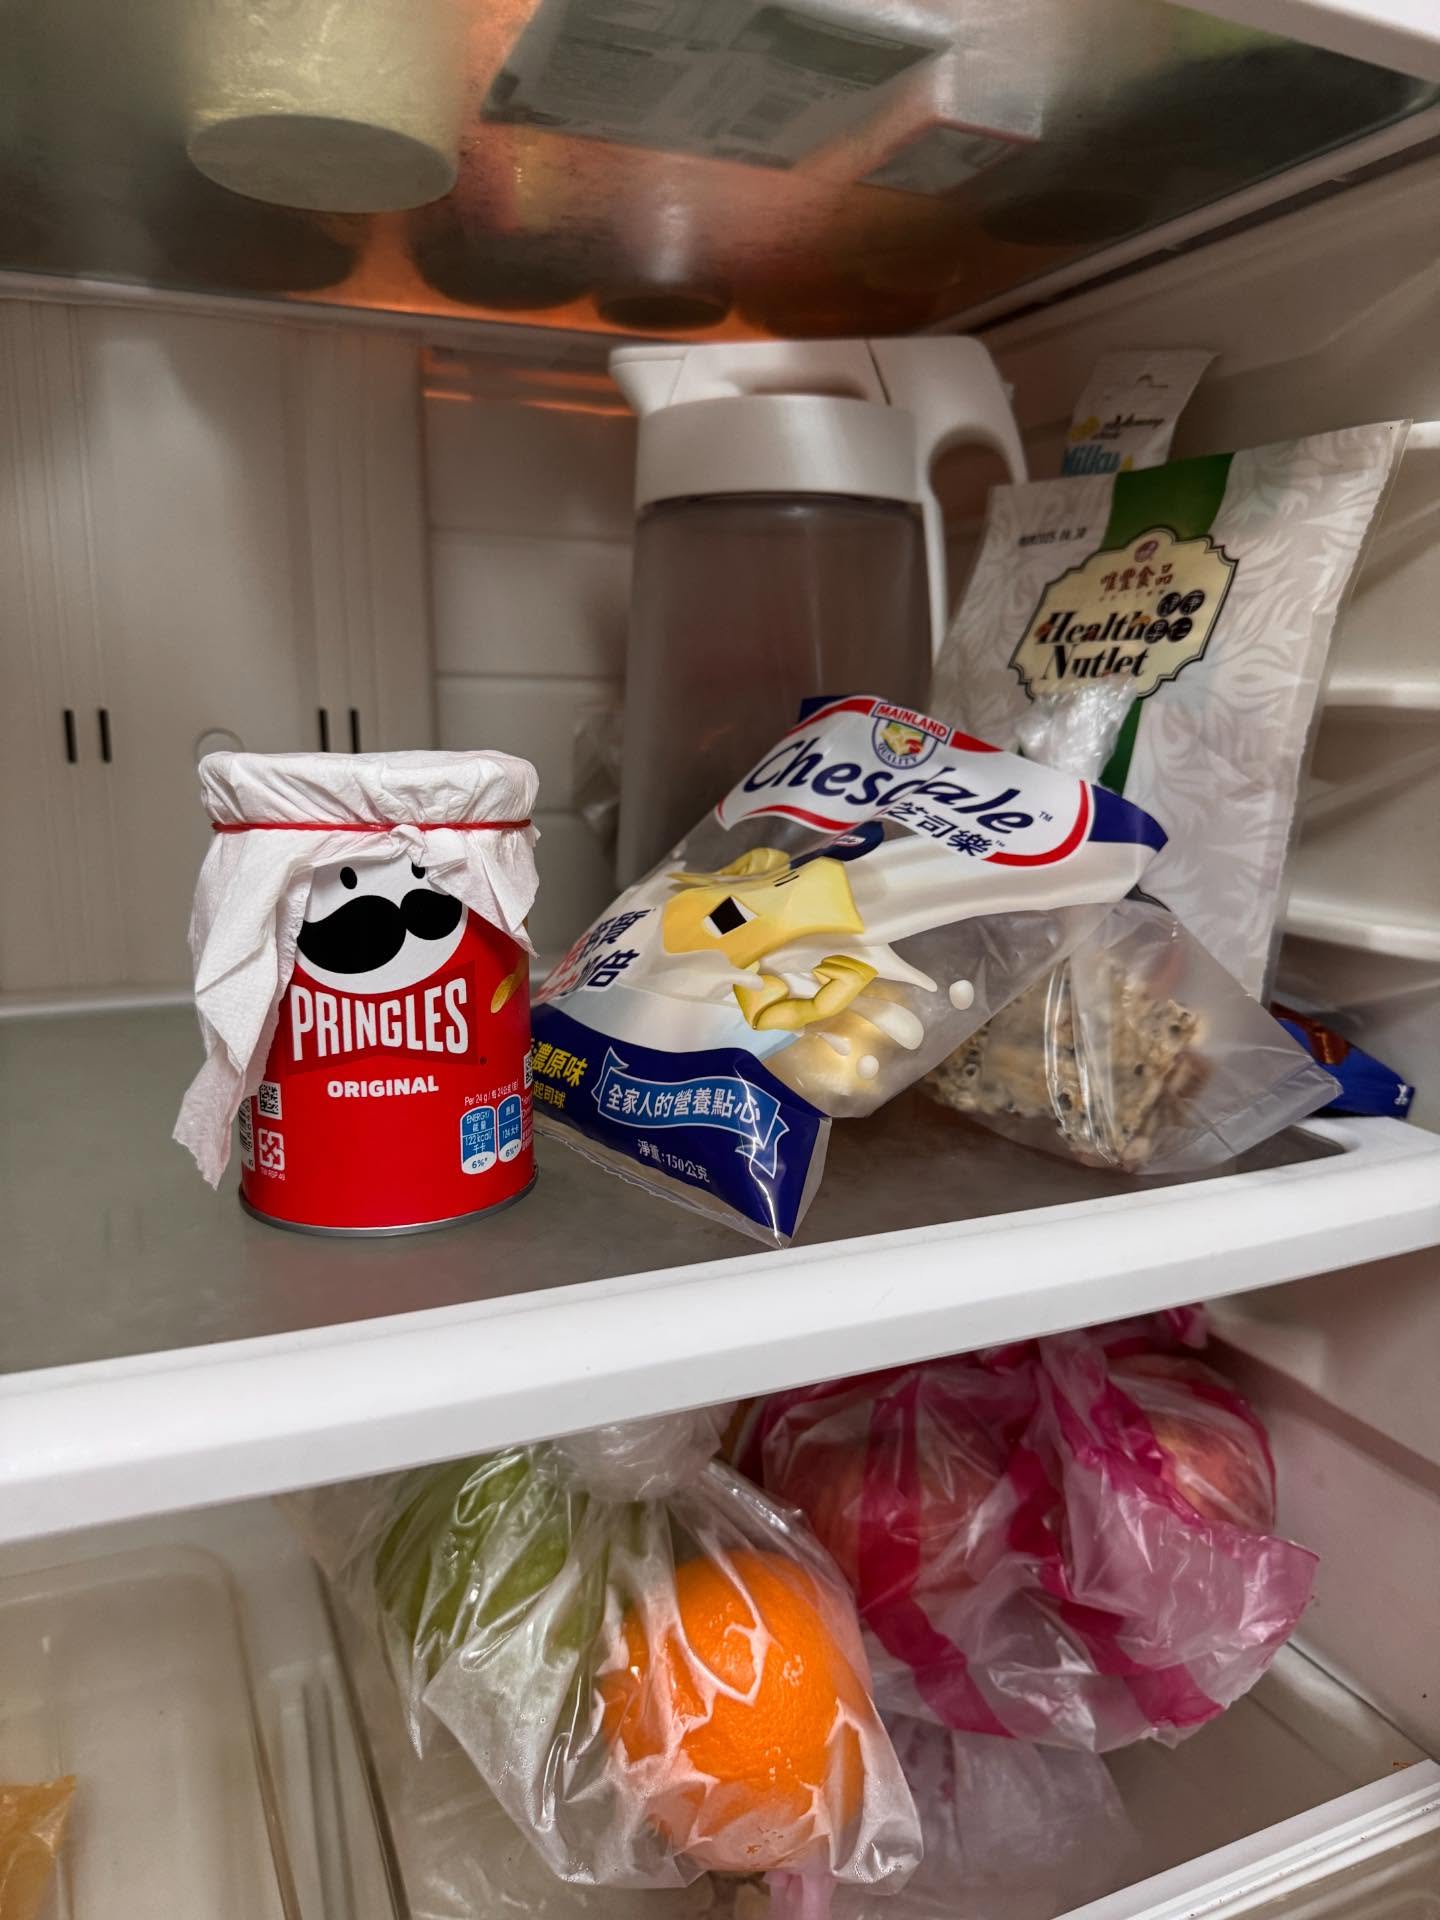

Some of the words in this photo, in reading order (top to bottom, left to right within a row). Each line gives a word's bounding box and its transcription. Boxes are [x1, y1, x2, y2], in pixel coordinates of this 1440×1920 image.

[1042, 645, 1151, 679] Nutlet
[877, 705, 947, 737] MAINLAND
[878, 743, 918, 765] QUALITY
[887, 802, 993, 857] 芝司樂
[290, 977, 469, 1061] PRINGLES
[531, 1038, 588, 1087] 濃原味
[327, 1075, 439, 1098] ORIGINAL
[464, 1096, 475, 1106] Per
[533, 1080, 566, 1109] 起司球
[606, 1083, 761, 1124] 全家人的營養點心
